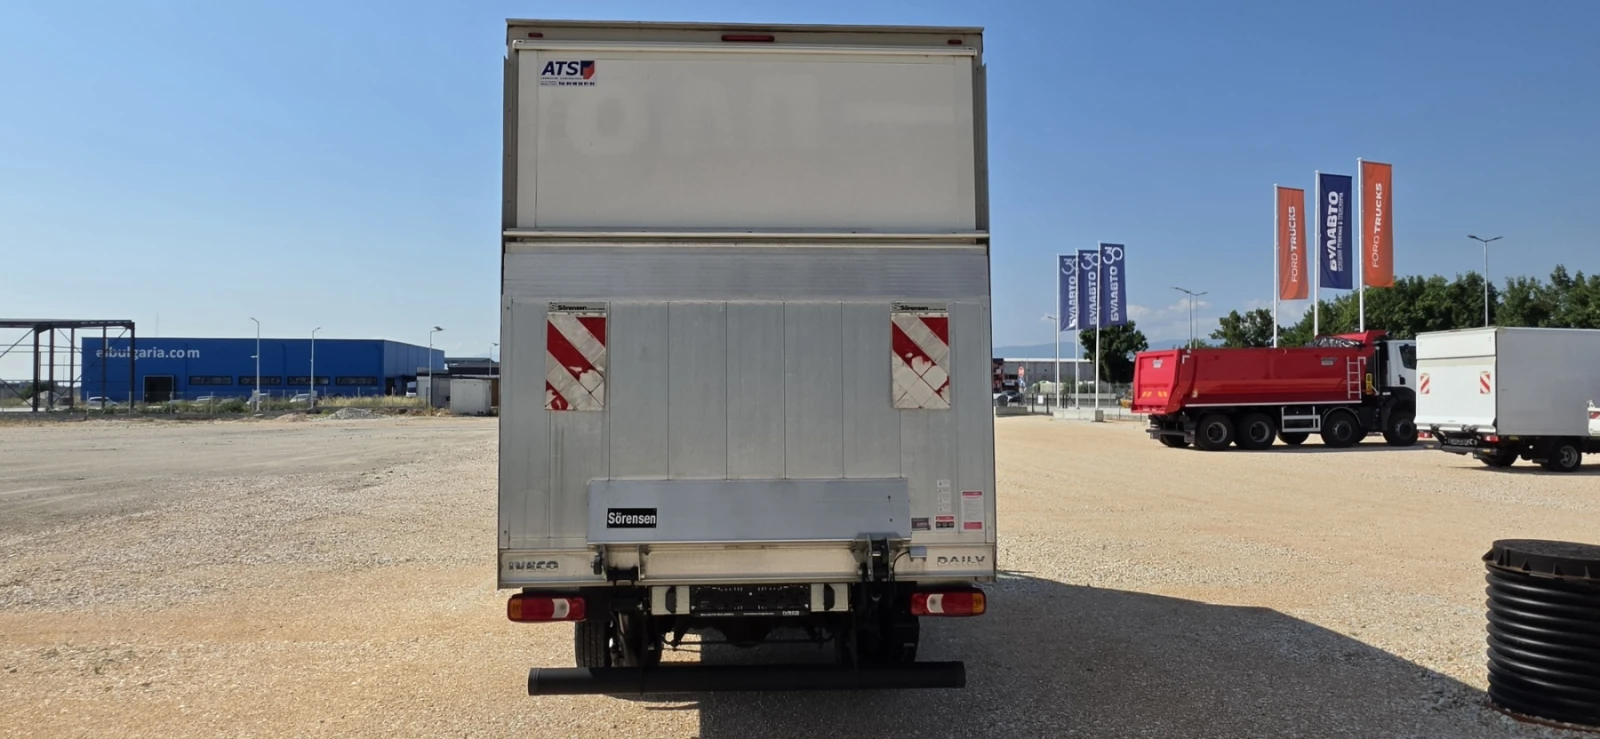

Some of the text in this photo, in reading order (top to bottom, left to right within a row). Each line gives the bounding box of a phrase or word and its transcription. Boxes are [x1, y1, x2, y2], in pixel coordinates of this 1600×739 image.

[541, 61, 579, 76] ATS
[1374, 183, 1382, 234] TRUCKS
[1288, 206, 1297, 252] TRUCKS
[1327, 191, 1339, 272] БУЛАВТО
[1102, 246, 1123, 265] 30
[1088, 271, 1097, 326] БУЛАВТО
[1110, 266, 1119, 322] БУЛАВТО
[608, 512, 656, 525] Sörensen
[508, 560, 559, 572] IVECO
[937, 556, 985, 566] DAILY
